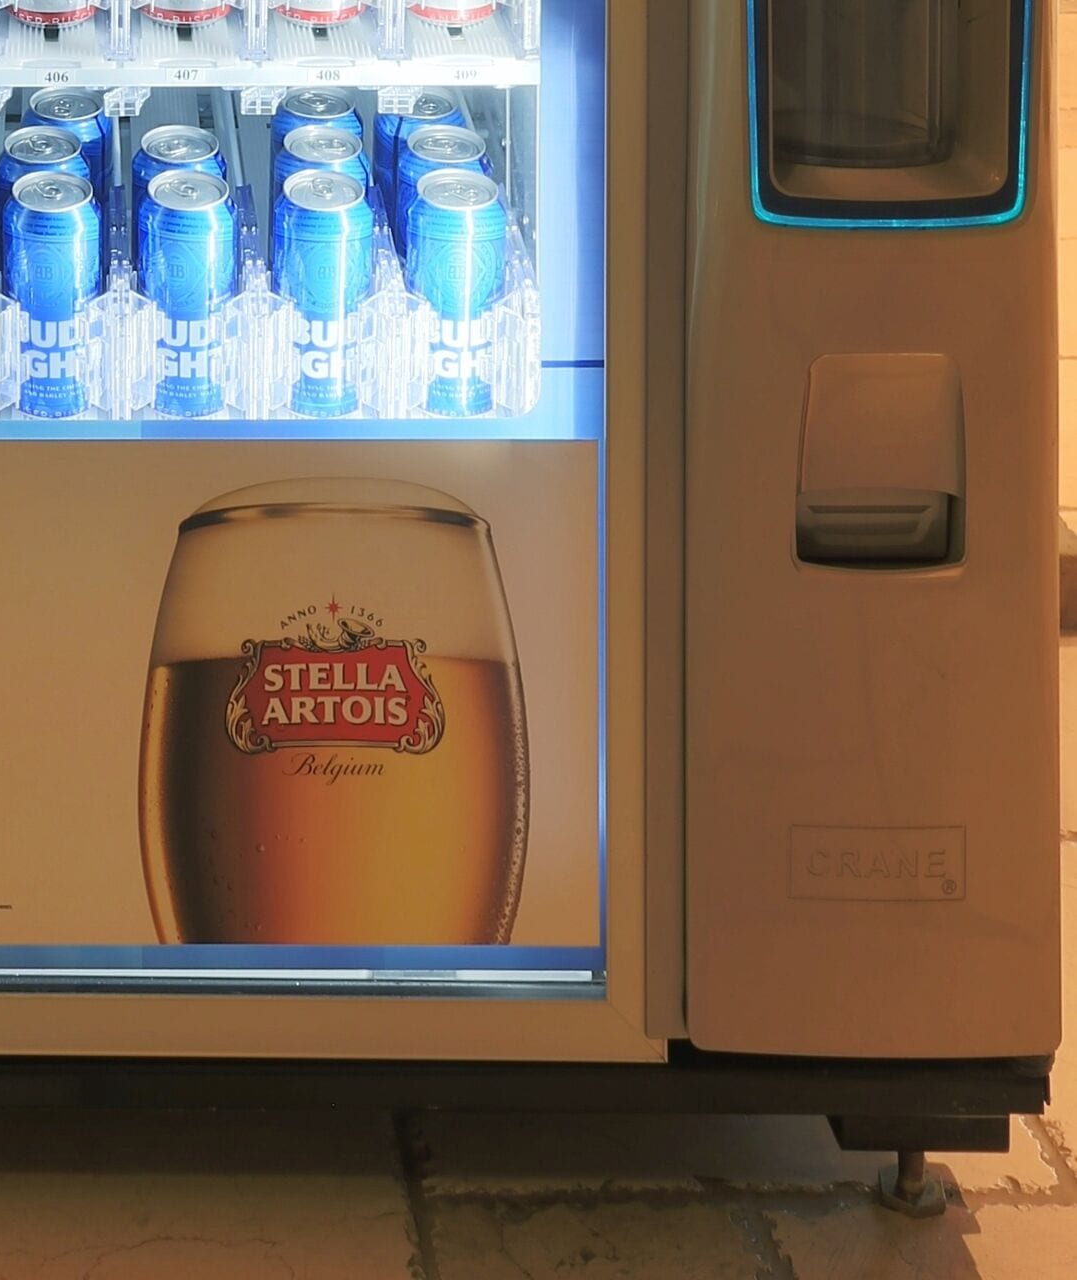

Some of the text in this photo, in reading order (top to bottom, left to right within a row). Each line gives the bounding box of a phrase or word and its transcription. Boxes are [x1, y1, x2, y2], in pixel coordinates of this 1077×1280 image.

[45, 71, 69, 83] 406
[174, 69, 198, 82] 407
[316, 69, 340, 82] 408
[454, 69, 477, 82] 409
[280, 605, 384, 629] ANNO 1366
[263, 663, 407, 692] STELLA
[261, 696, 408, 726] ARTOIS
[282, 753, 385, 786] Belgium
[806, 849, 948, 879] CRANE
